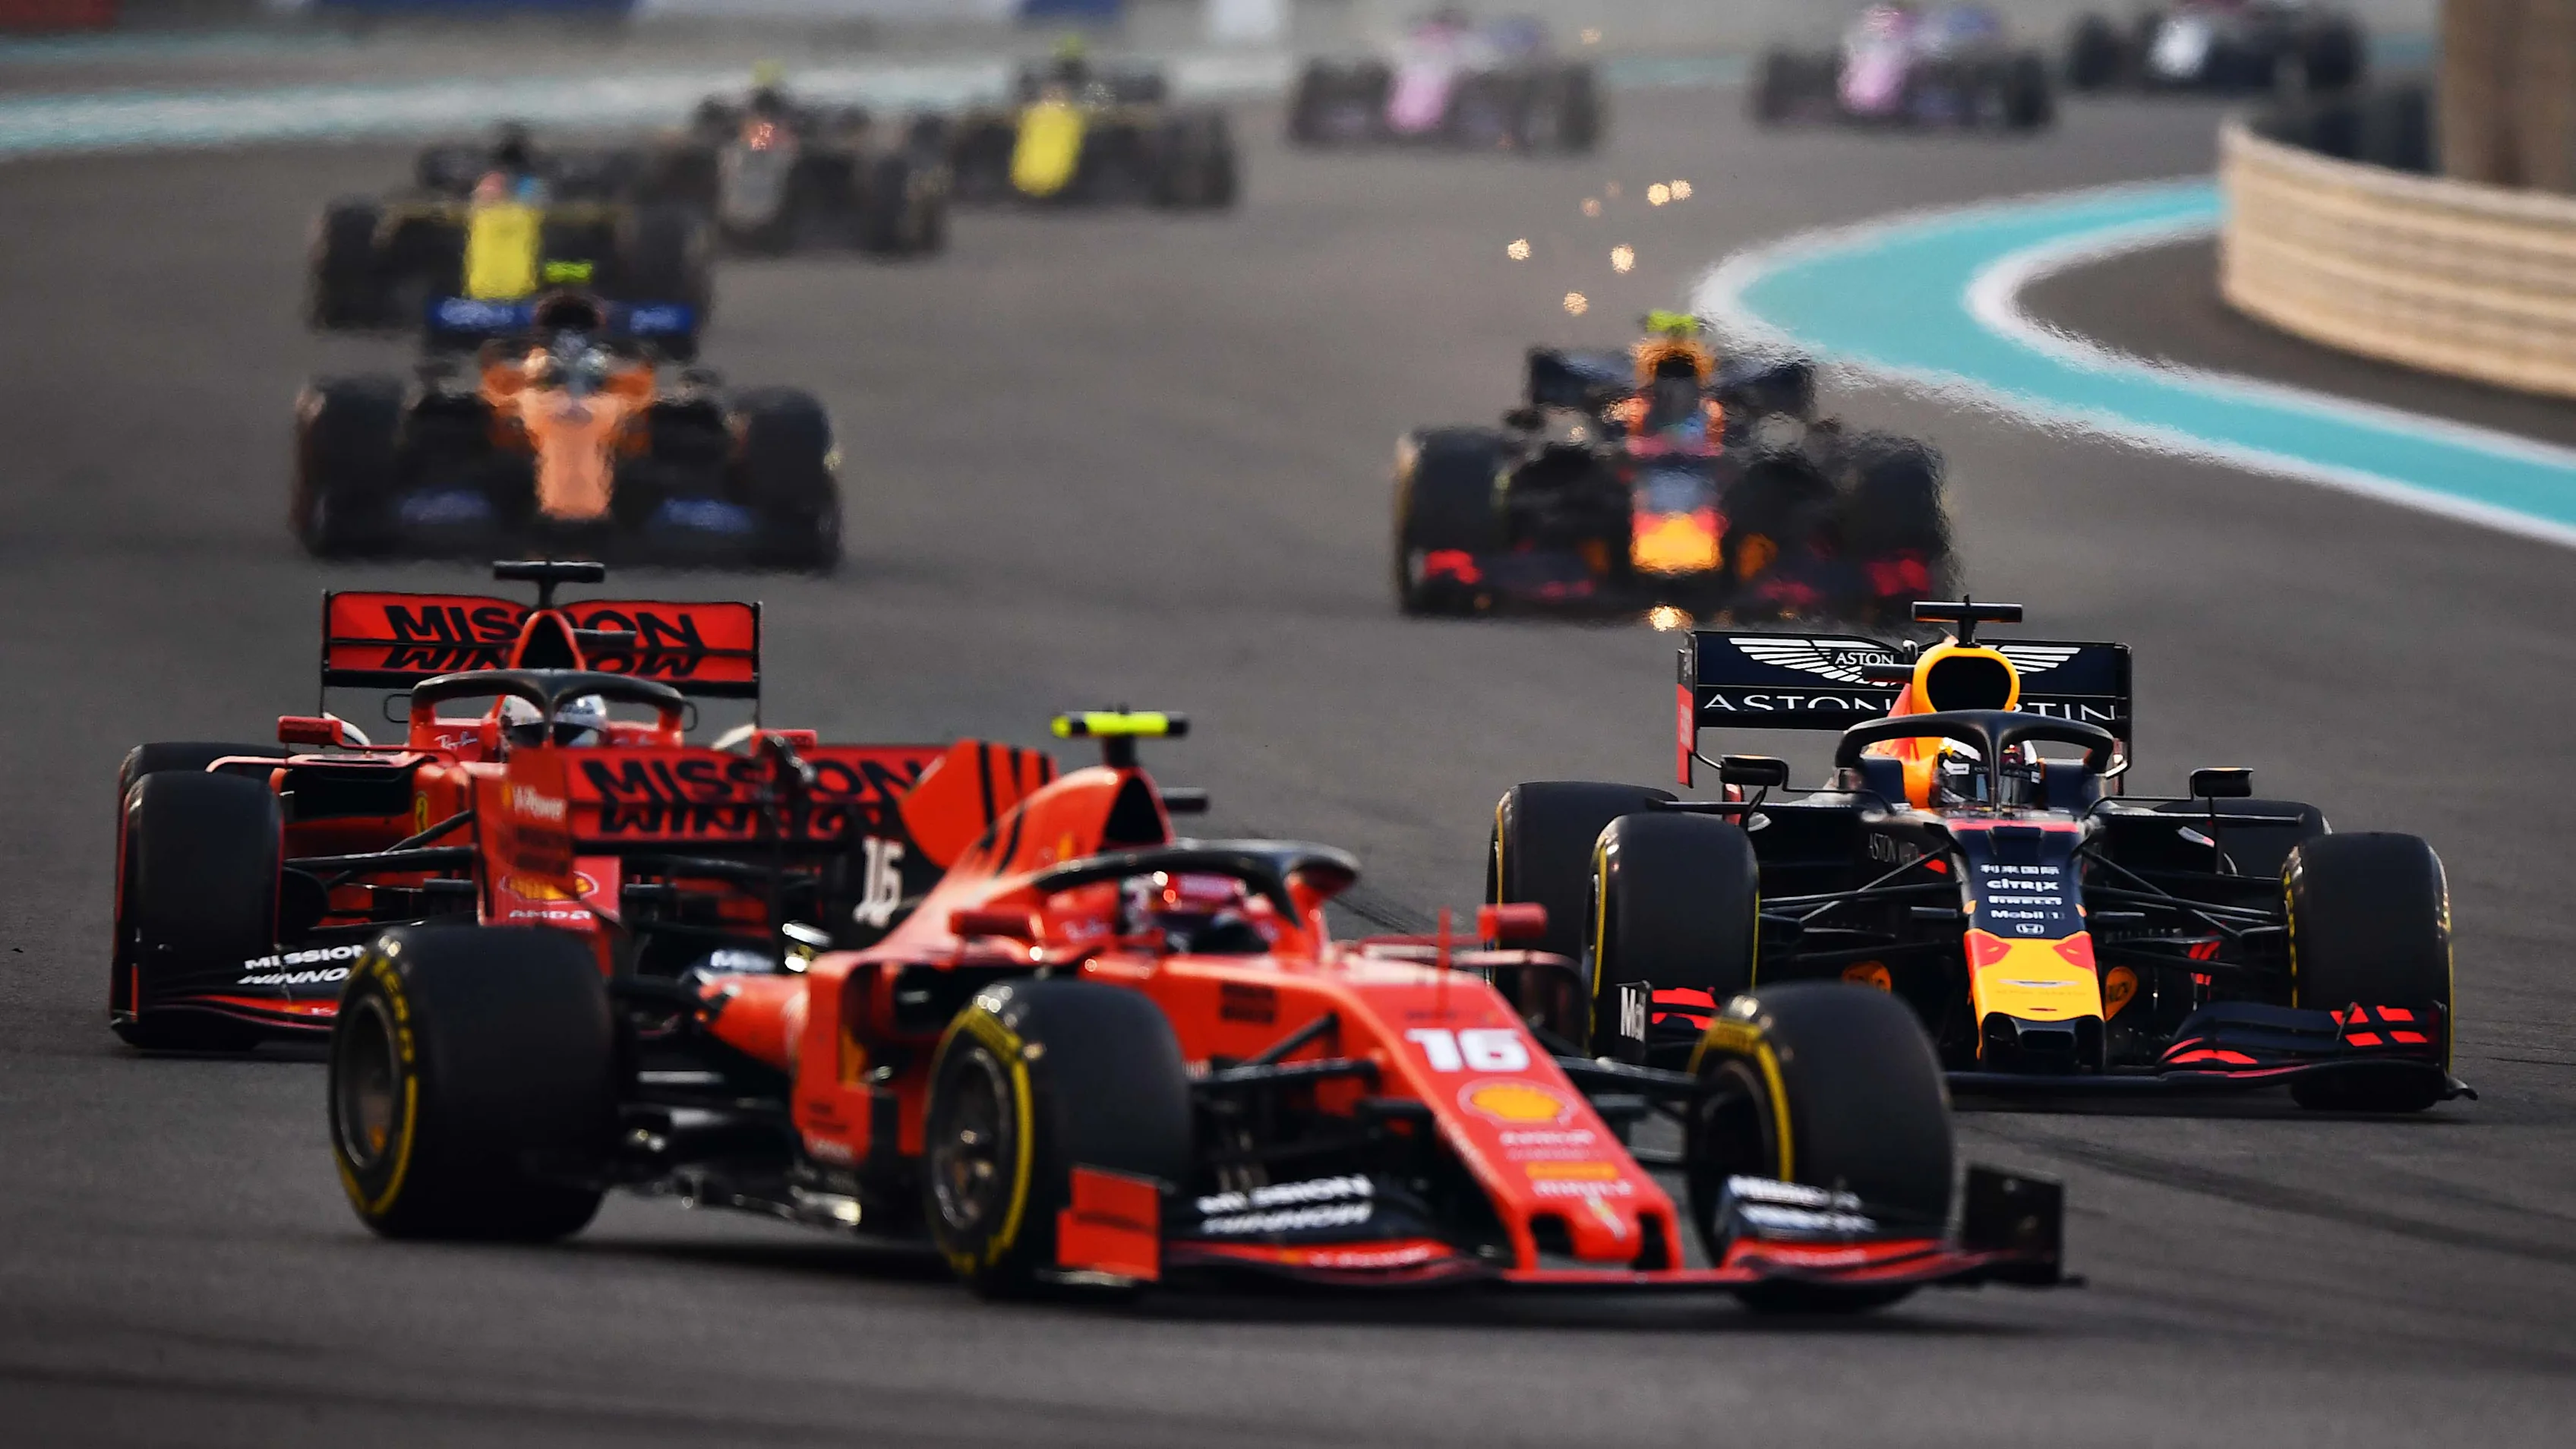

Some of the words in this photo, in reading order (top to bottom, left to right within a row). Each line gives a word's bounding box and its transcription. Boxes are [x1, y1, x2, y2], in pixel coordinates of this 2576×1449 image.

[1835, 652, 1894, 665] ASTON
[1990, 910, 2044, 919] Mobil
[236, 968, 350, 985] WINNO
[1403, 1028, 1530, 1072] 16
